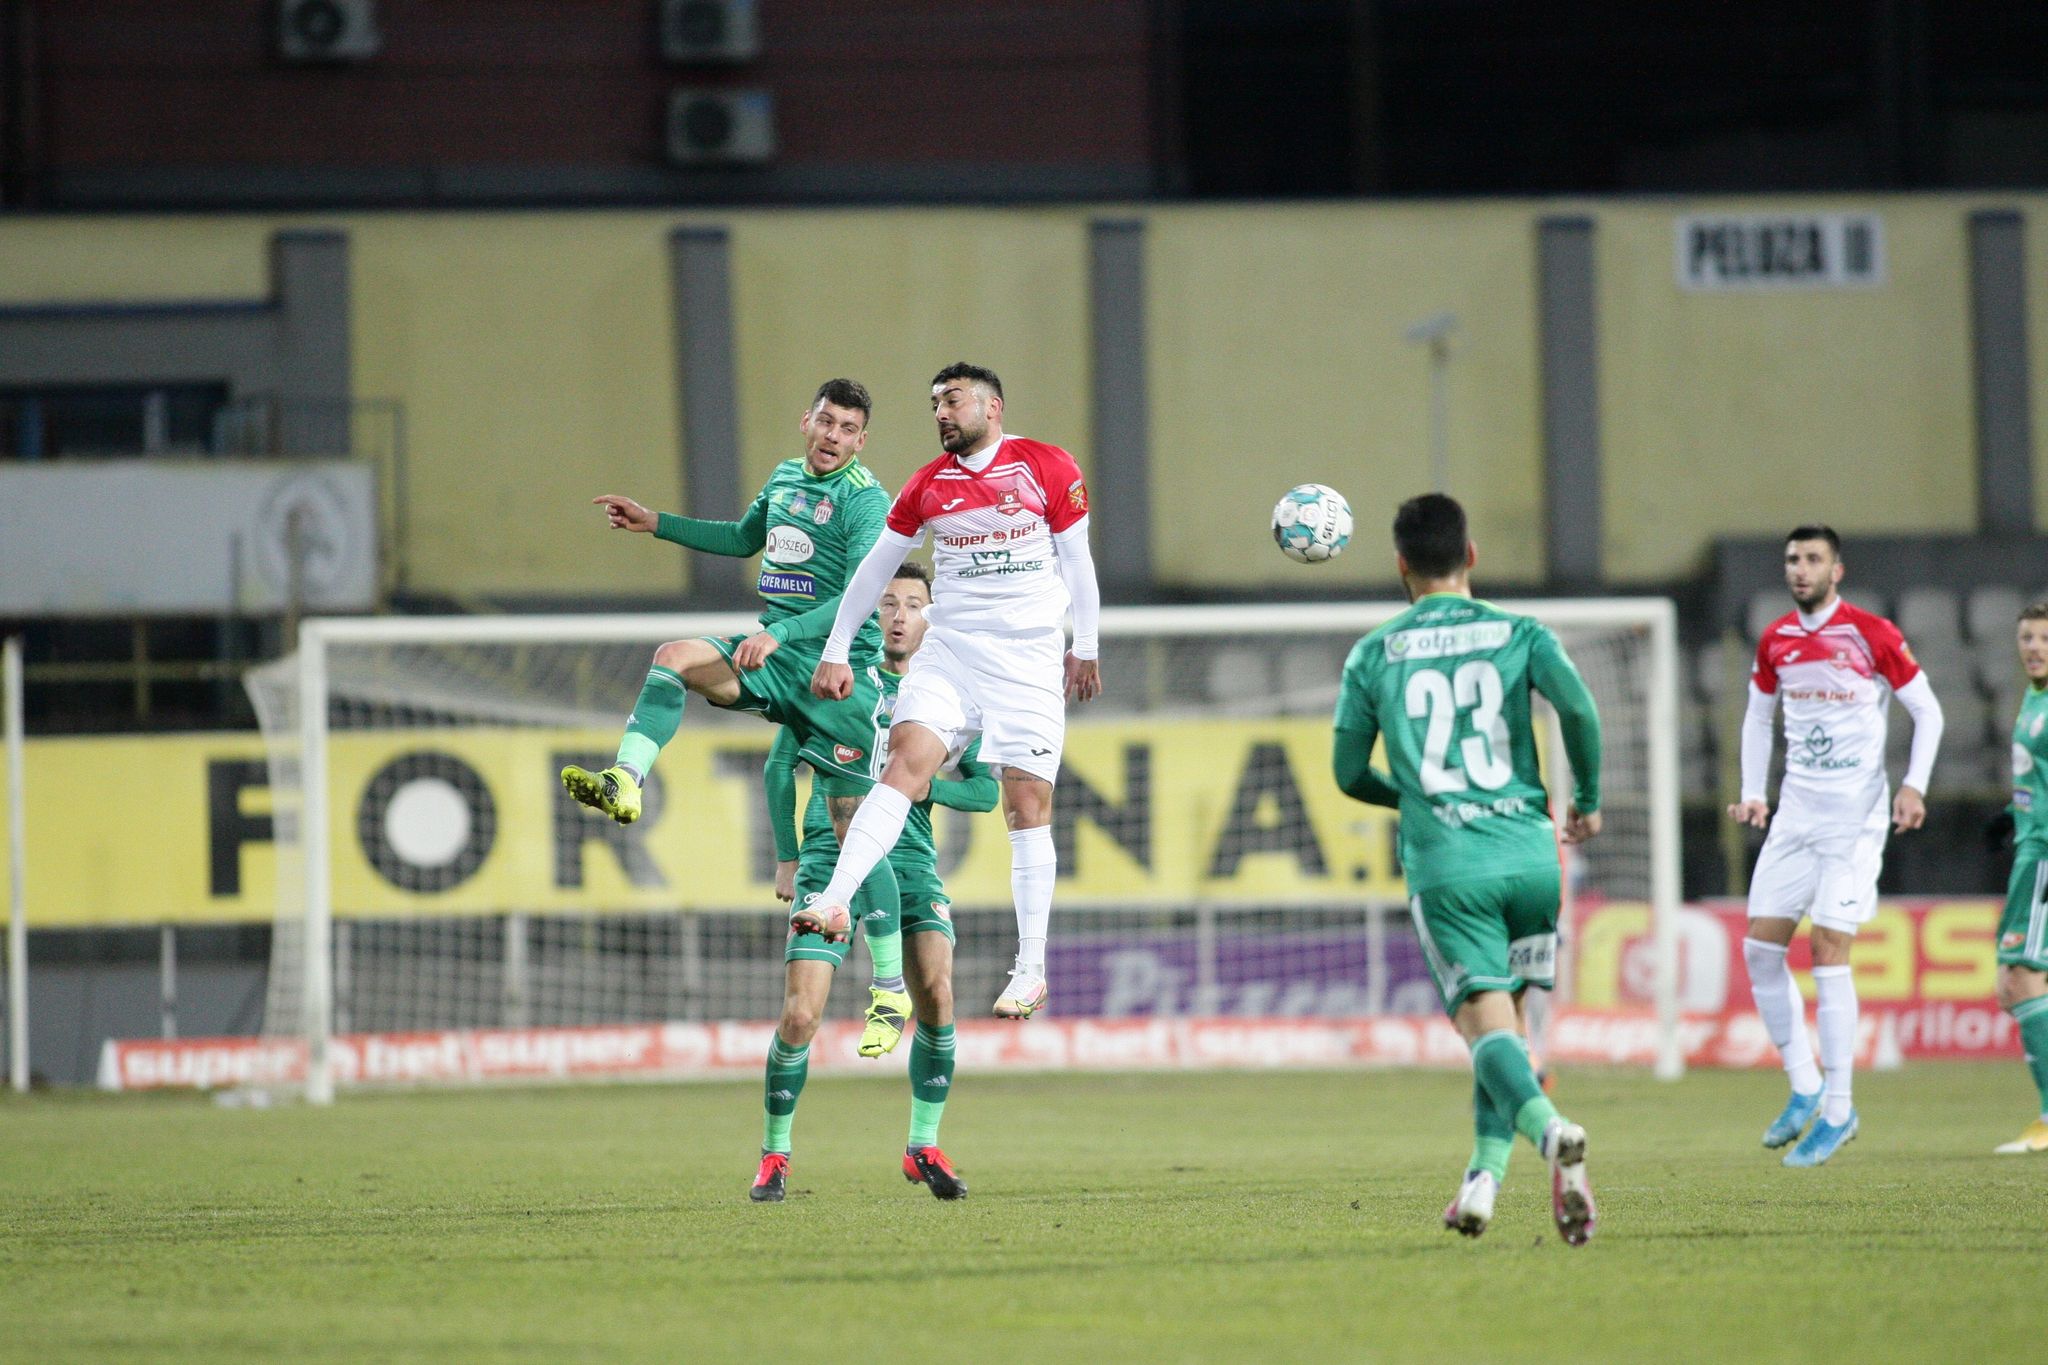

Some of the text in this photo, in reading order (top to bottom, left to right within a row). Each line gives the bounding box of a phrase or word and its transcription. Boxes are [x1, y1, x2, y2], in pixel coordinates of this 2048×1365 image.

[943, 521, 1038, 549] super bet
[760, 574, 813, 593] GYERMELYI
[1404, 659, 1513, 797] 23
[836, 747, 855, 758] MOL
